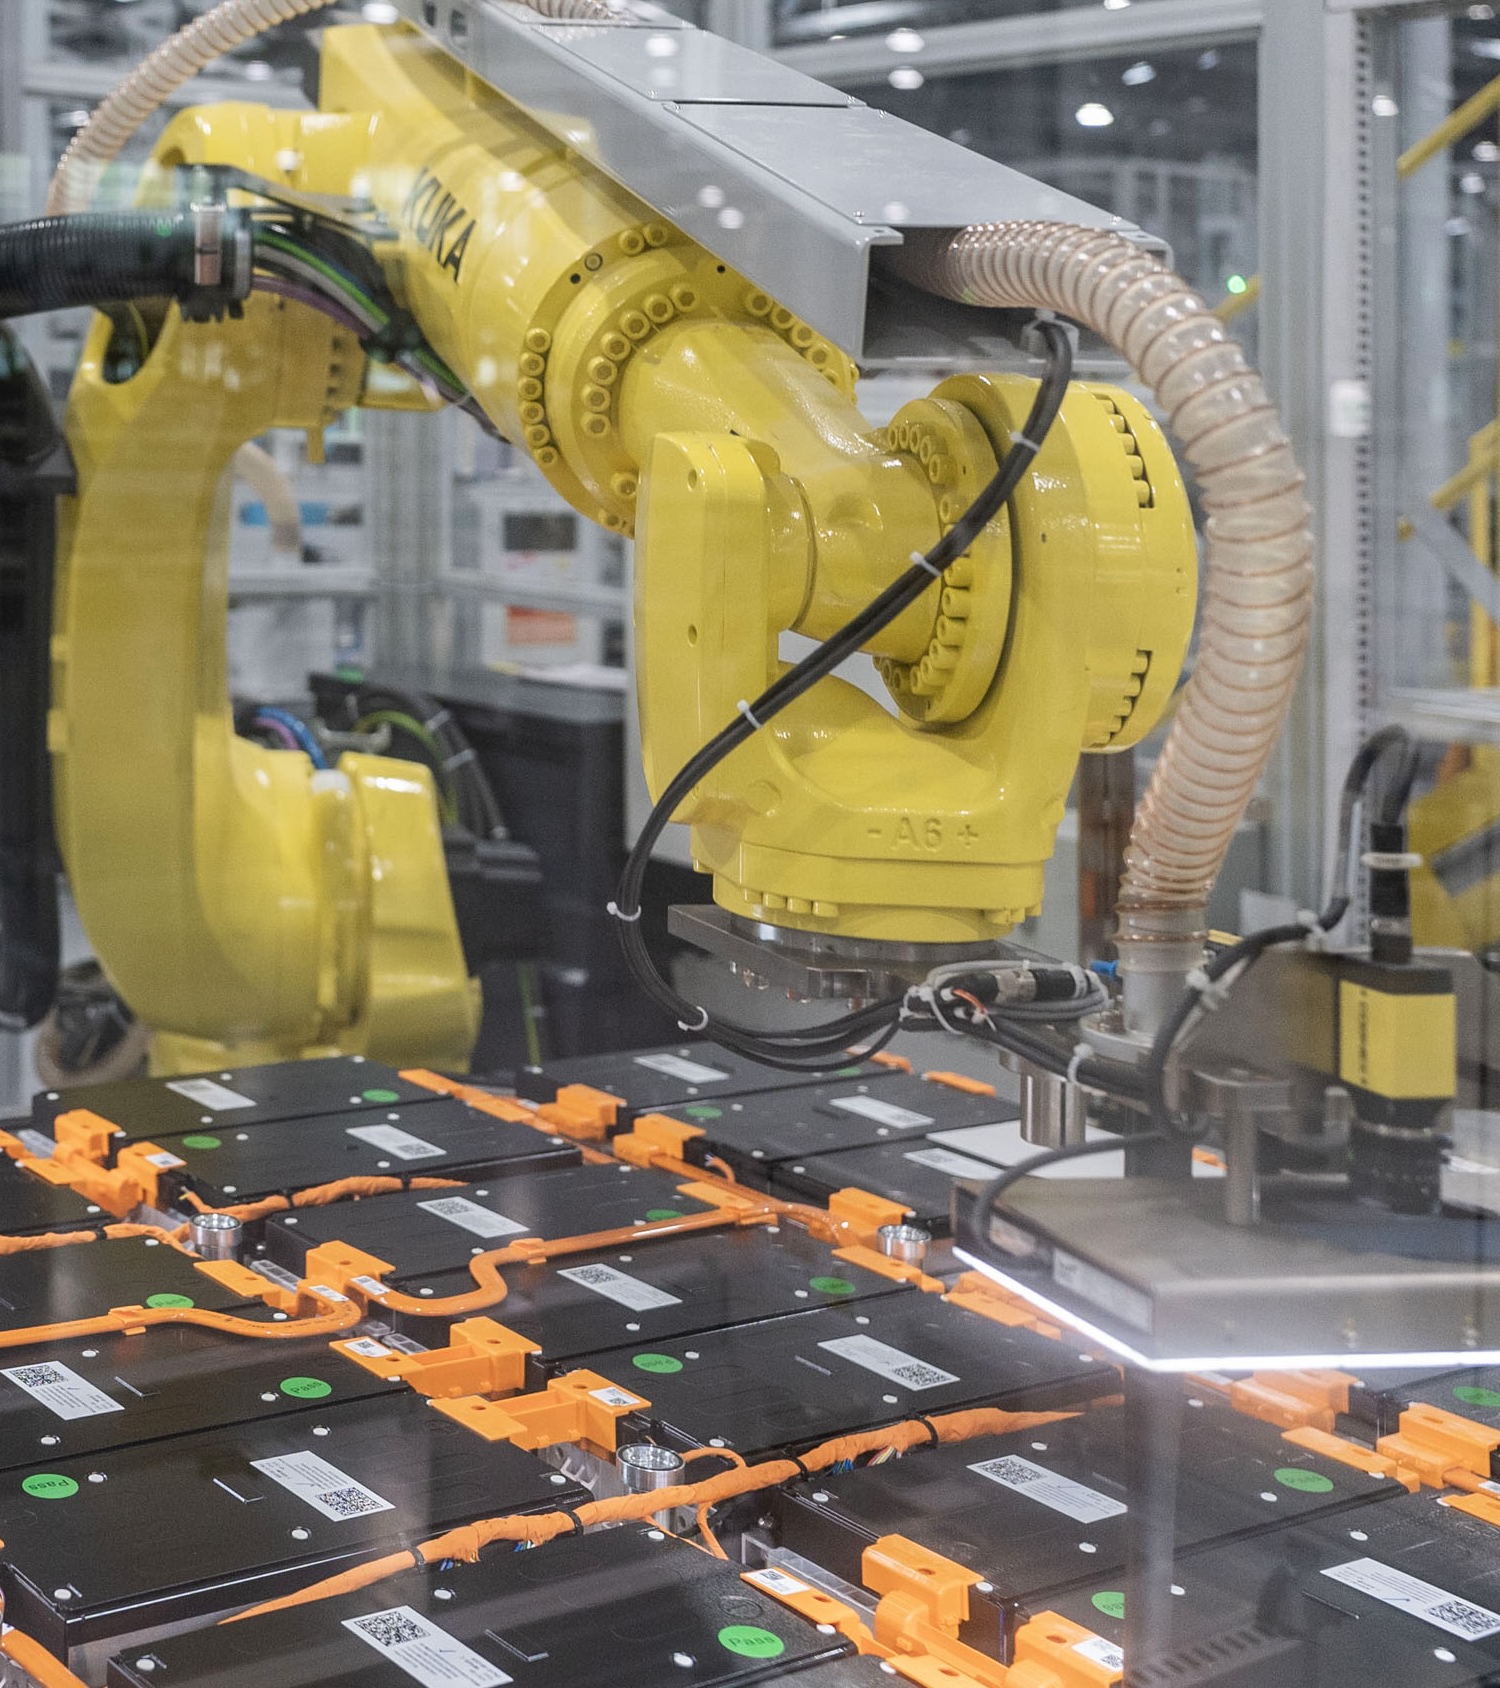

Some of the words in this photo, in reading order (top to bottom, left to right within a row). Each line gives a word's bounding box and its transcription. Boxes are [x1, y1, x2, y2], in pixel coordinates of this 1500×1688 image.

[402, 166, 476, 283] KUKA
[890, 816, 941, 852] A6
[290, 1381, 322, 1394] Pass
[28, 1479, 69, 1490] Pass
[728, 1636, 777, 1647] Pass
